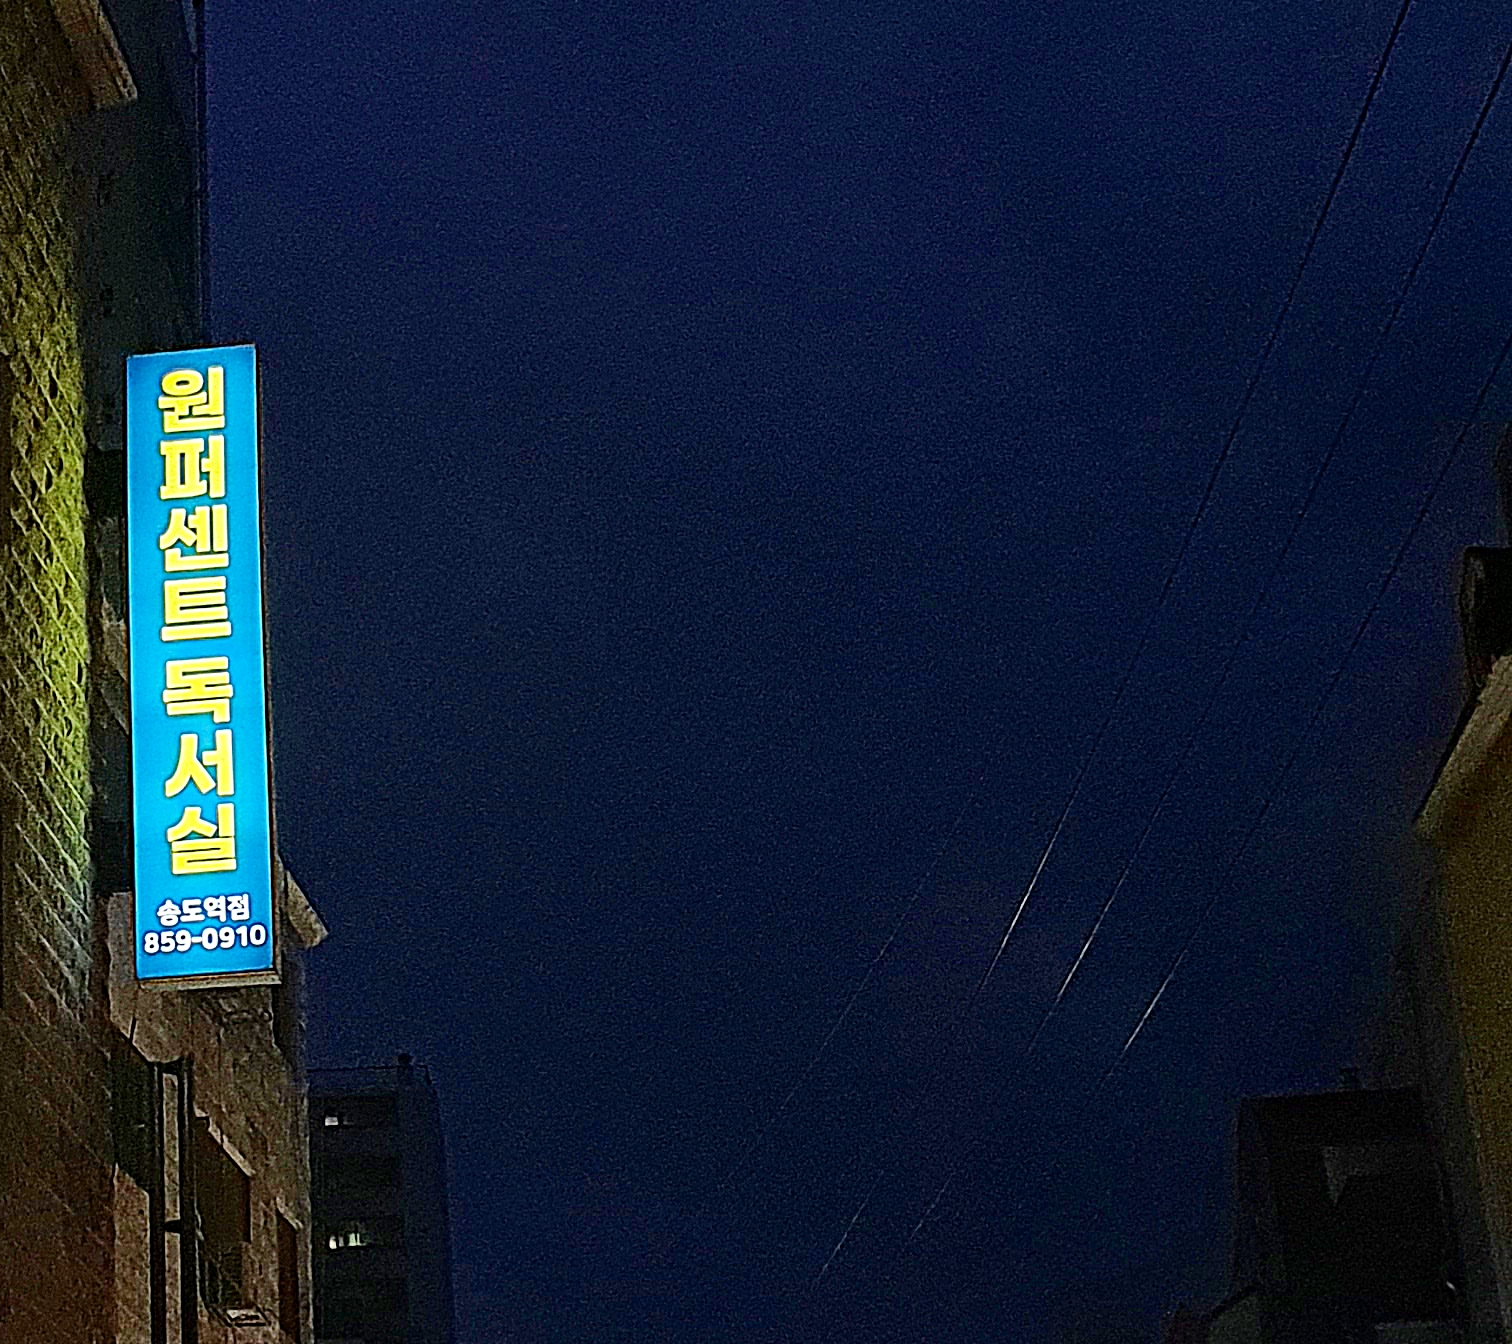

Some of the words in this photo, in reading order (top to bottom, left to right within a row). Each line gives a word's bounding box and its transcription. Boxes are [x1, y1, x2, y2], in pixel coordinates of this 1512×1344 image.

[157, 365, 233, 642] 원퍼센트
[162, 656, 239, 876] 독서실
[142, 923, 267, 954] 859-0910
[156, 893, 251, 927] 송도역점
